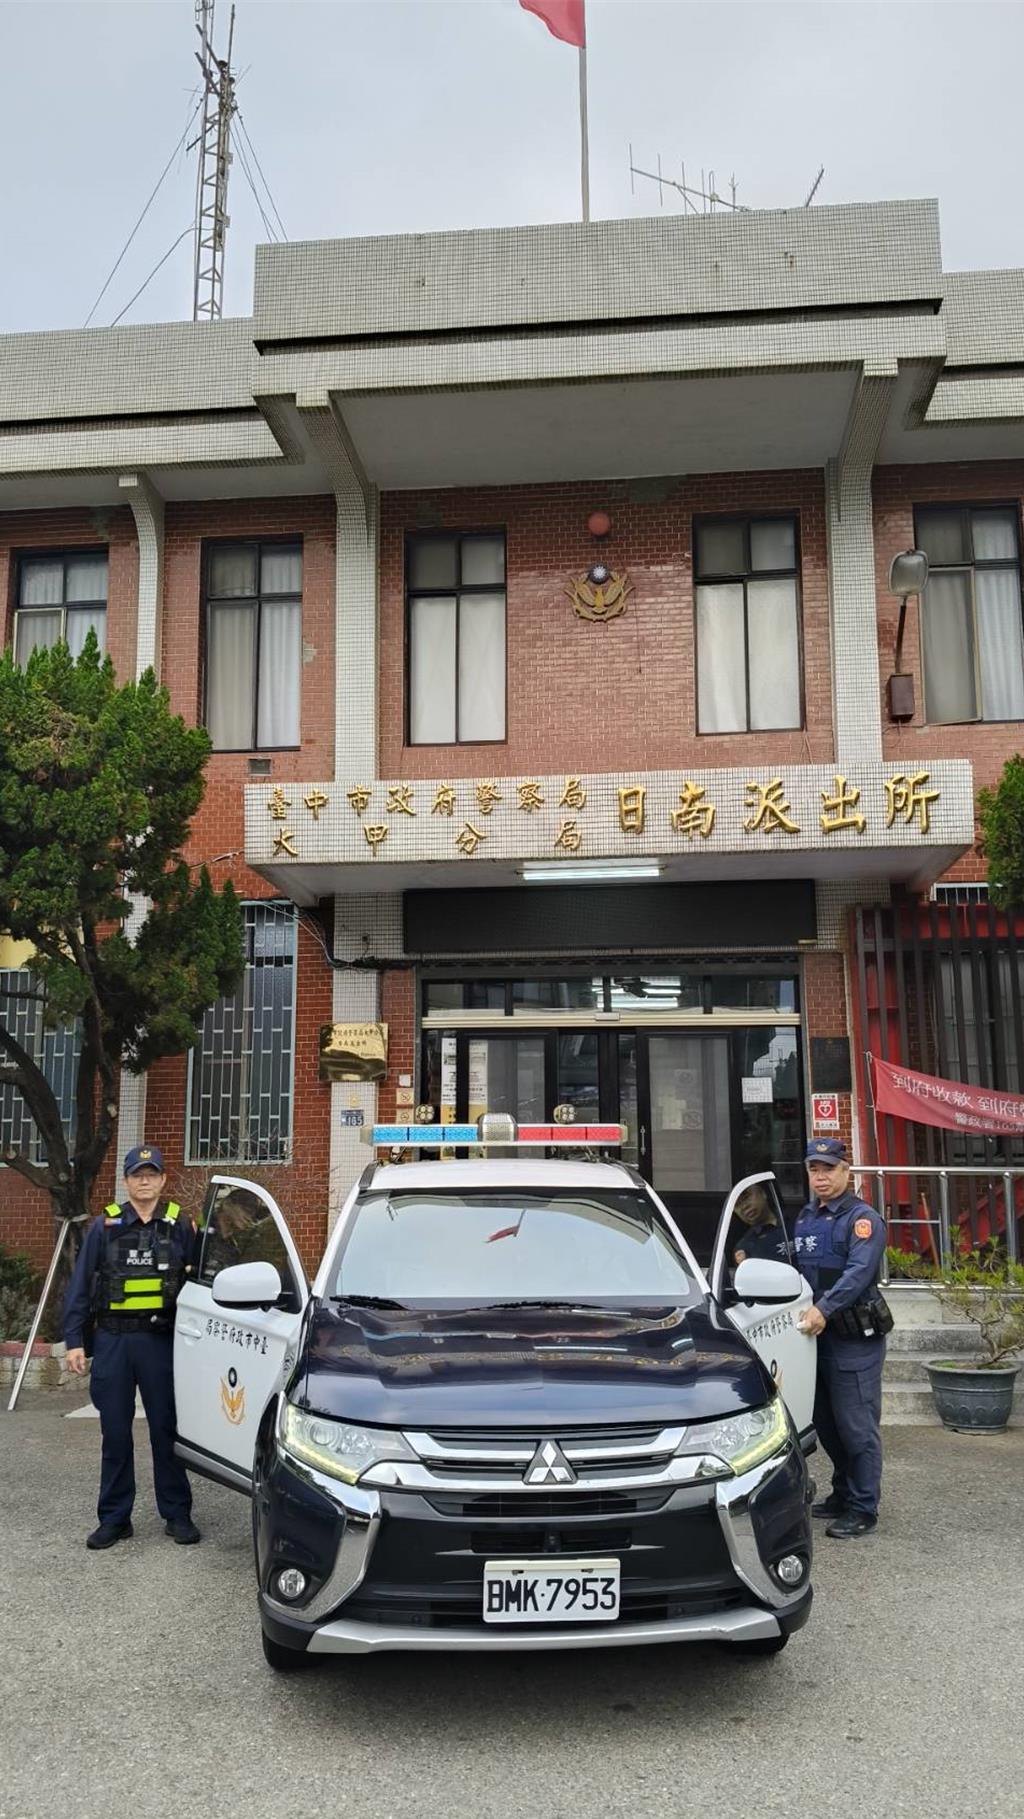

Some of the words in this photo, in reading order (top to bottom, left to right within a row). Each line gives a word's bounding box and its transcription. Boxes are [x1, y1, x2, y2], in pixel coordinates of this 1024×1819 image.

[267, 777, 587, 820] 臺中市政府警察局
[618, 769, 940, 840] 日南派出所
[273, 820, 582, 857] 大甲分局
[890, 1071, 974, 1109] 到府收款
[126, 1257, 153, 1266] POLICE
